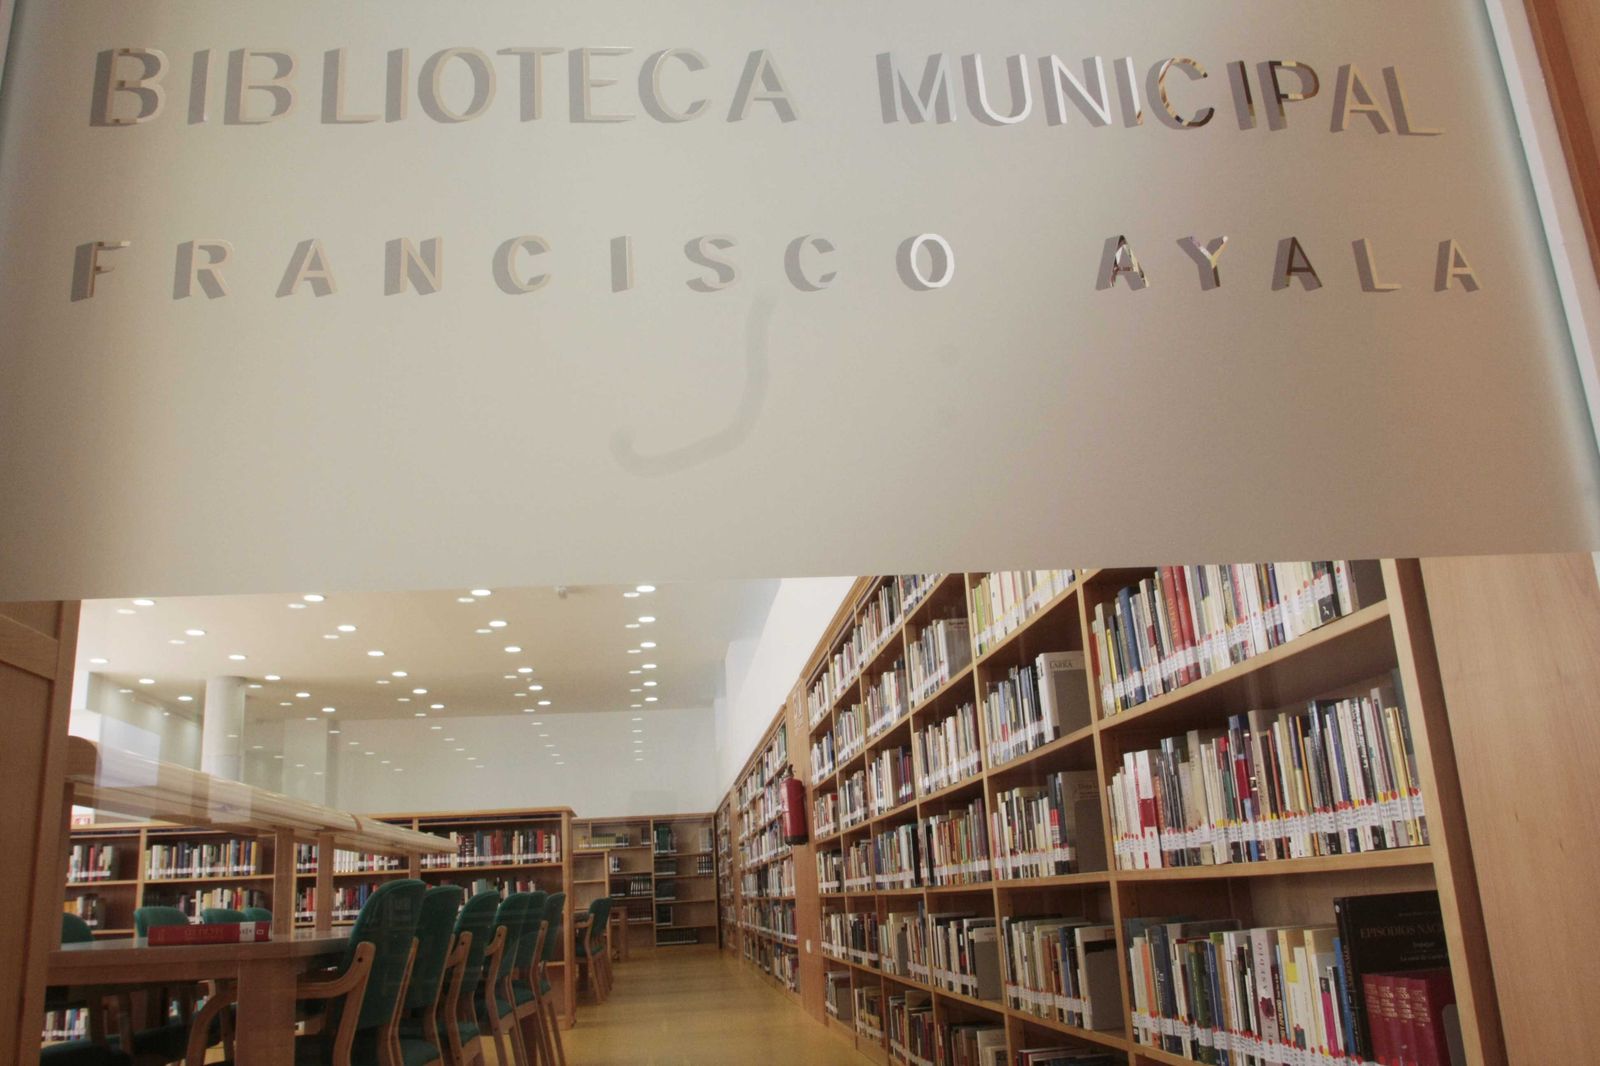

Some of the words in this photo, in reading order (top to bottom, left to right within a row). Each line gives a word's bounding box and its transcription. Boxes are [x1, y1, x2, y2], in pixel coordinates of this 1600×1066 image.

[90, 47, 798, 127] BIBLIOTECA
[876, 51, 1445, 136] MUNICIPAL
[70, 233, 955, 302] FRANCISCO
[1095, 234, 1482, 293] AYALA
